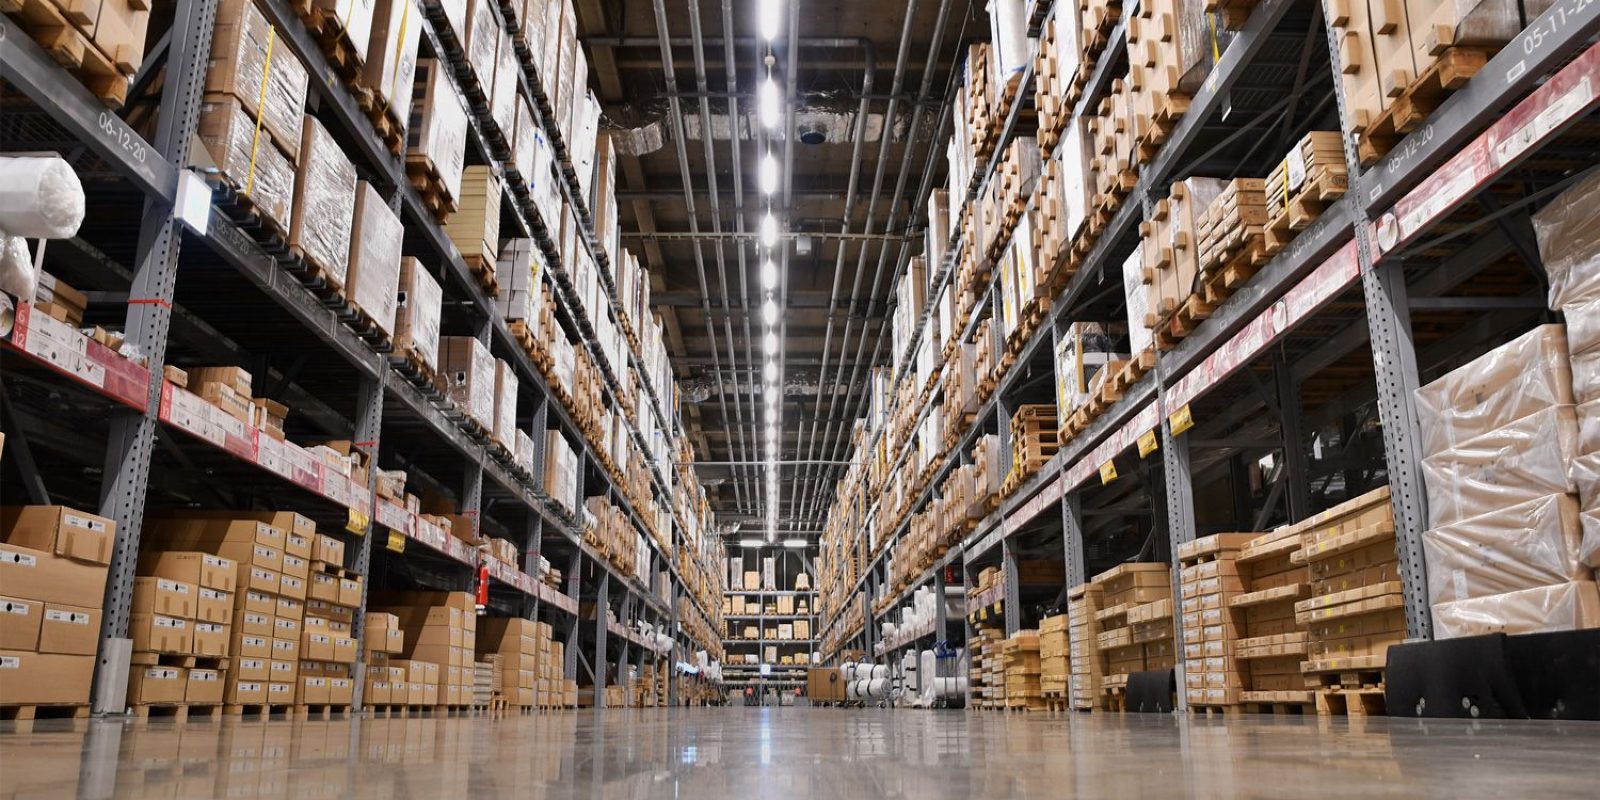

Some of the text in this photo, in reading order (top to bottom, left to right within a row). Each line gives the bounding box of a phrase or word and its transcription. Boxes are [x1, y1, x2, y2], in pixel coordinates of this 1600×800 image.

[1524, 0, 1593, 54] 05-11-2
[98, 112, 146, 163] 06-12-20
[1387, 123, 1434, 174] 05-12-20
[15, 330, 25, 347] 12
[18, 310, 26, 322] 6
